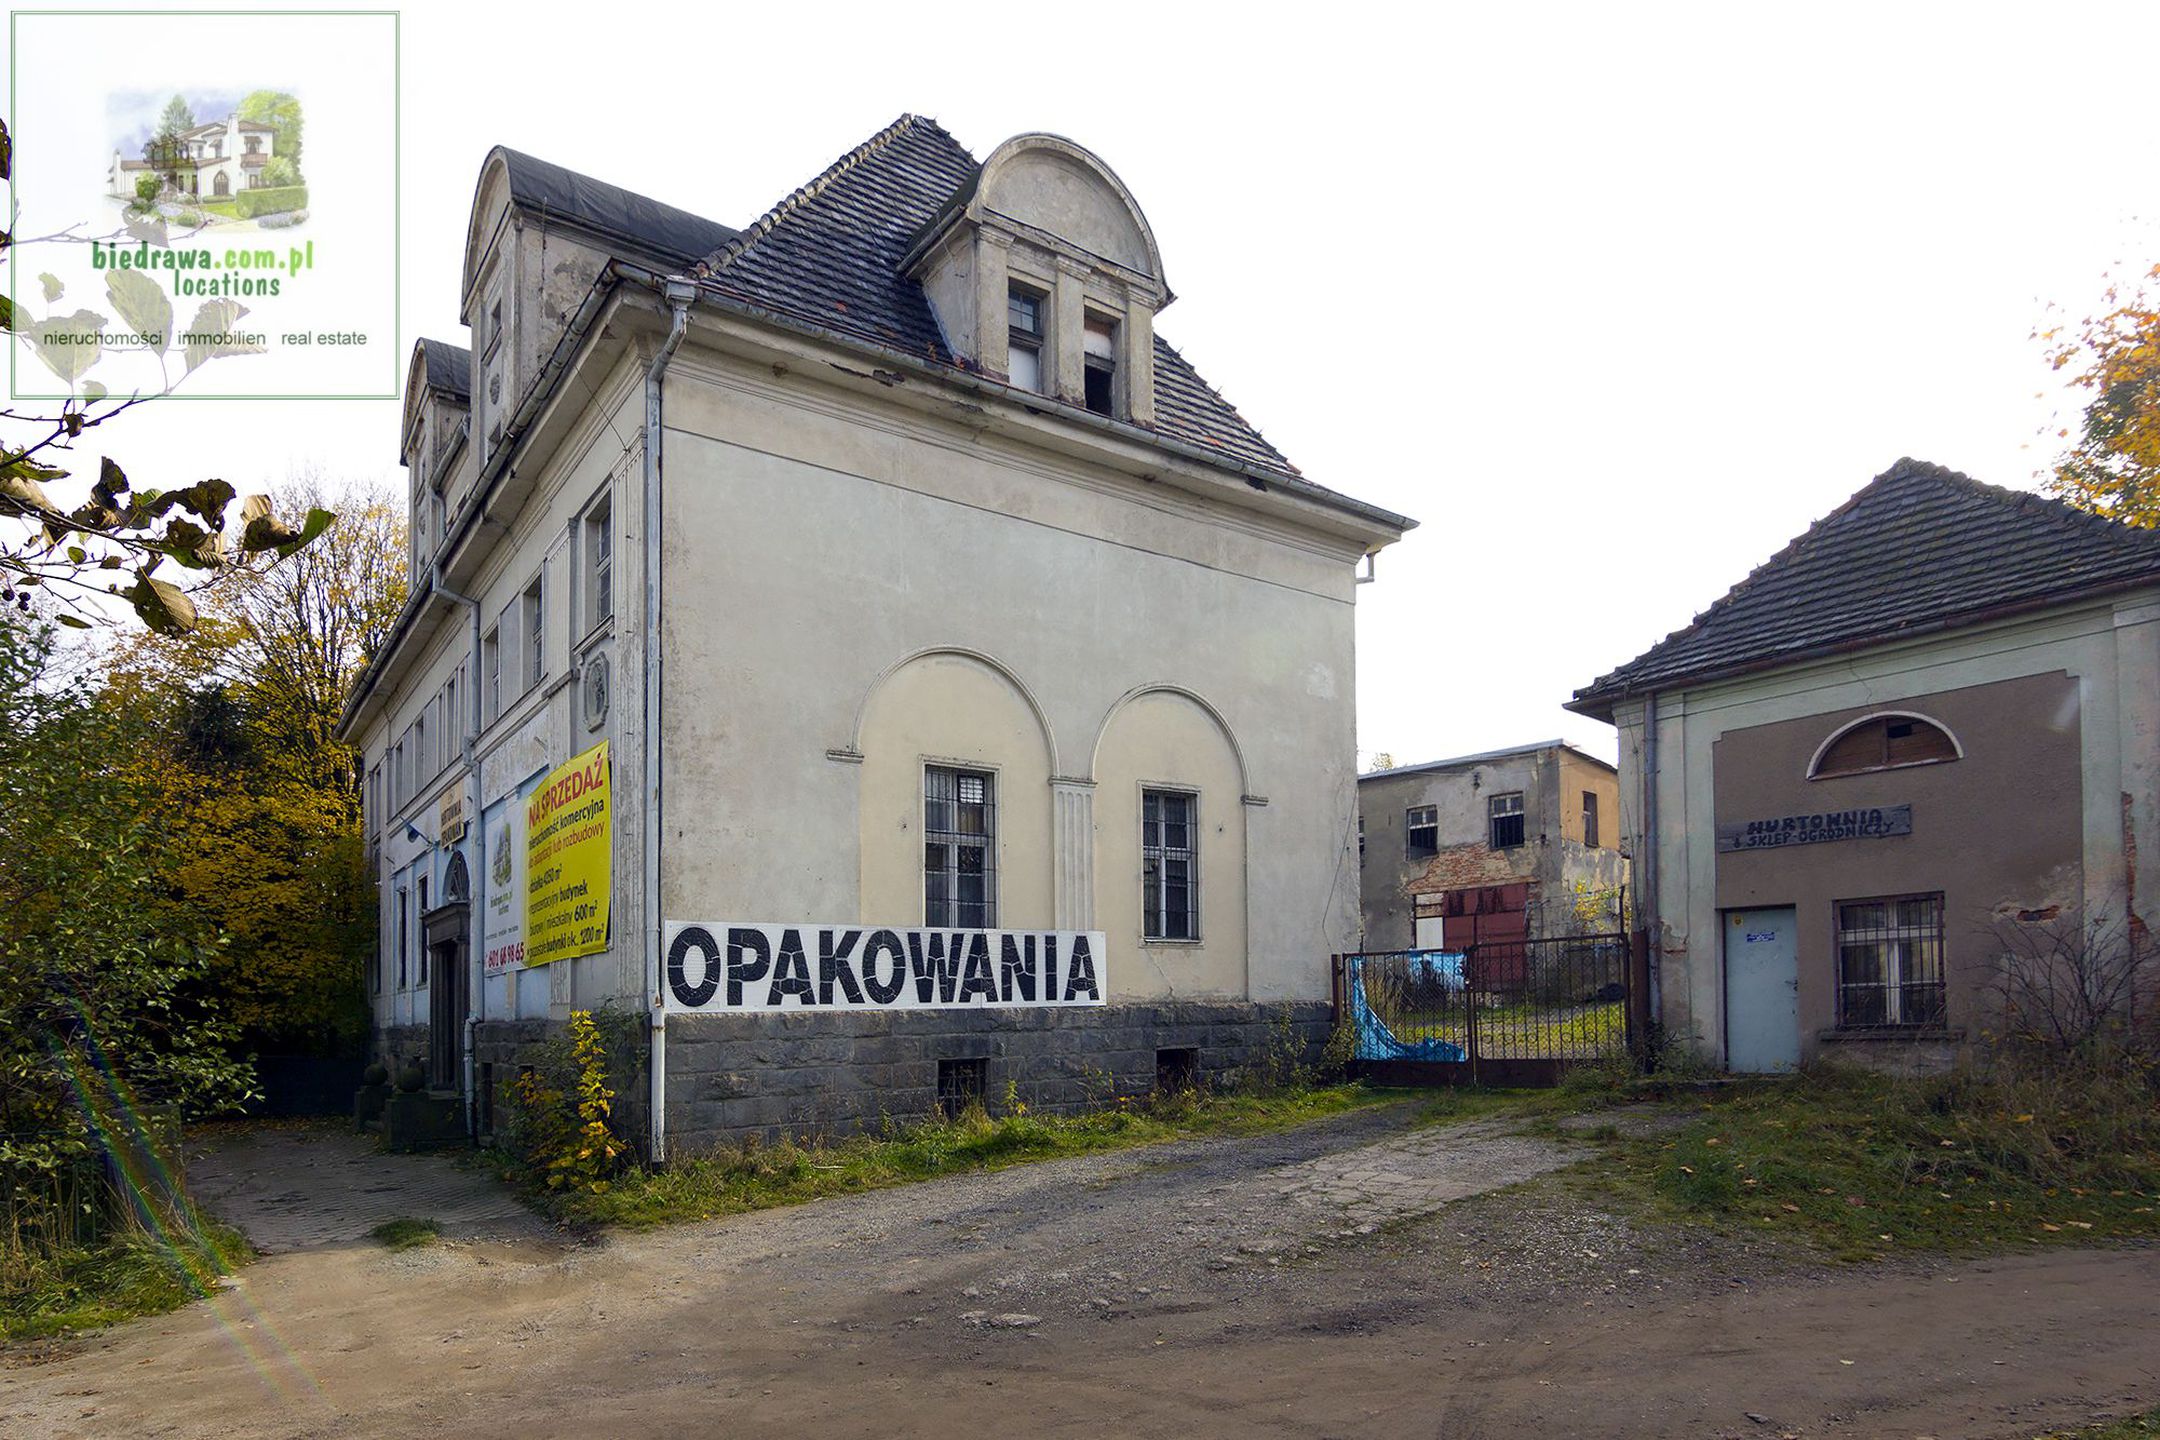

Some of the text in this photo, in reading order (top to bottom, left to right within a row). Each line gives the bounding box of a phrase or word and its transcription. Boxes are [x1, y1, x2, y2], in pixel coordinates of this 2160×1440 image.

[541, 752, 604, 819] SPRZEDAŻ
[559, 798, 605, 830] komercyjna
[562, 821, 605, 846] rozbudowy
[559, 879, 588, 903] budynek
[667, 926, 1101, 1008] OPAKOWANIA
